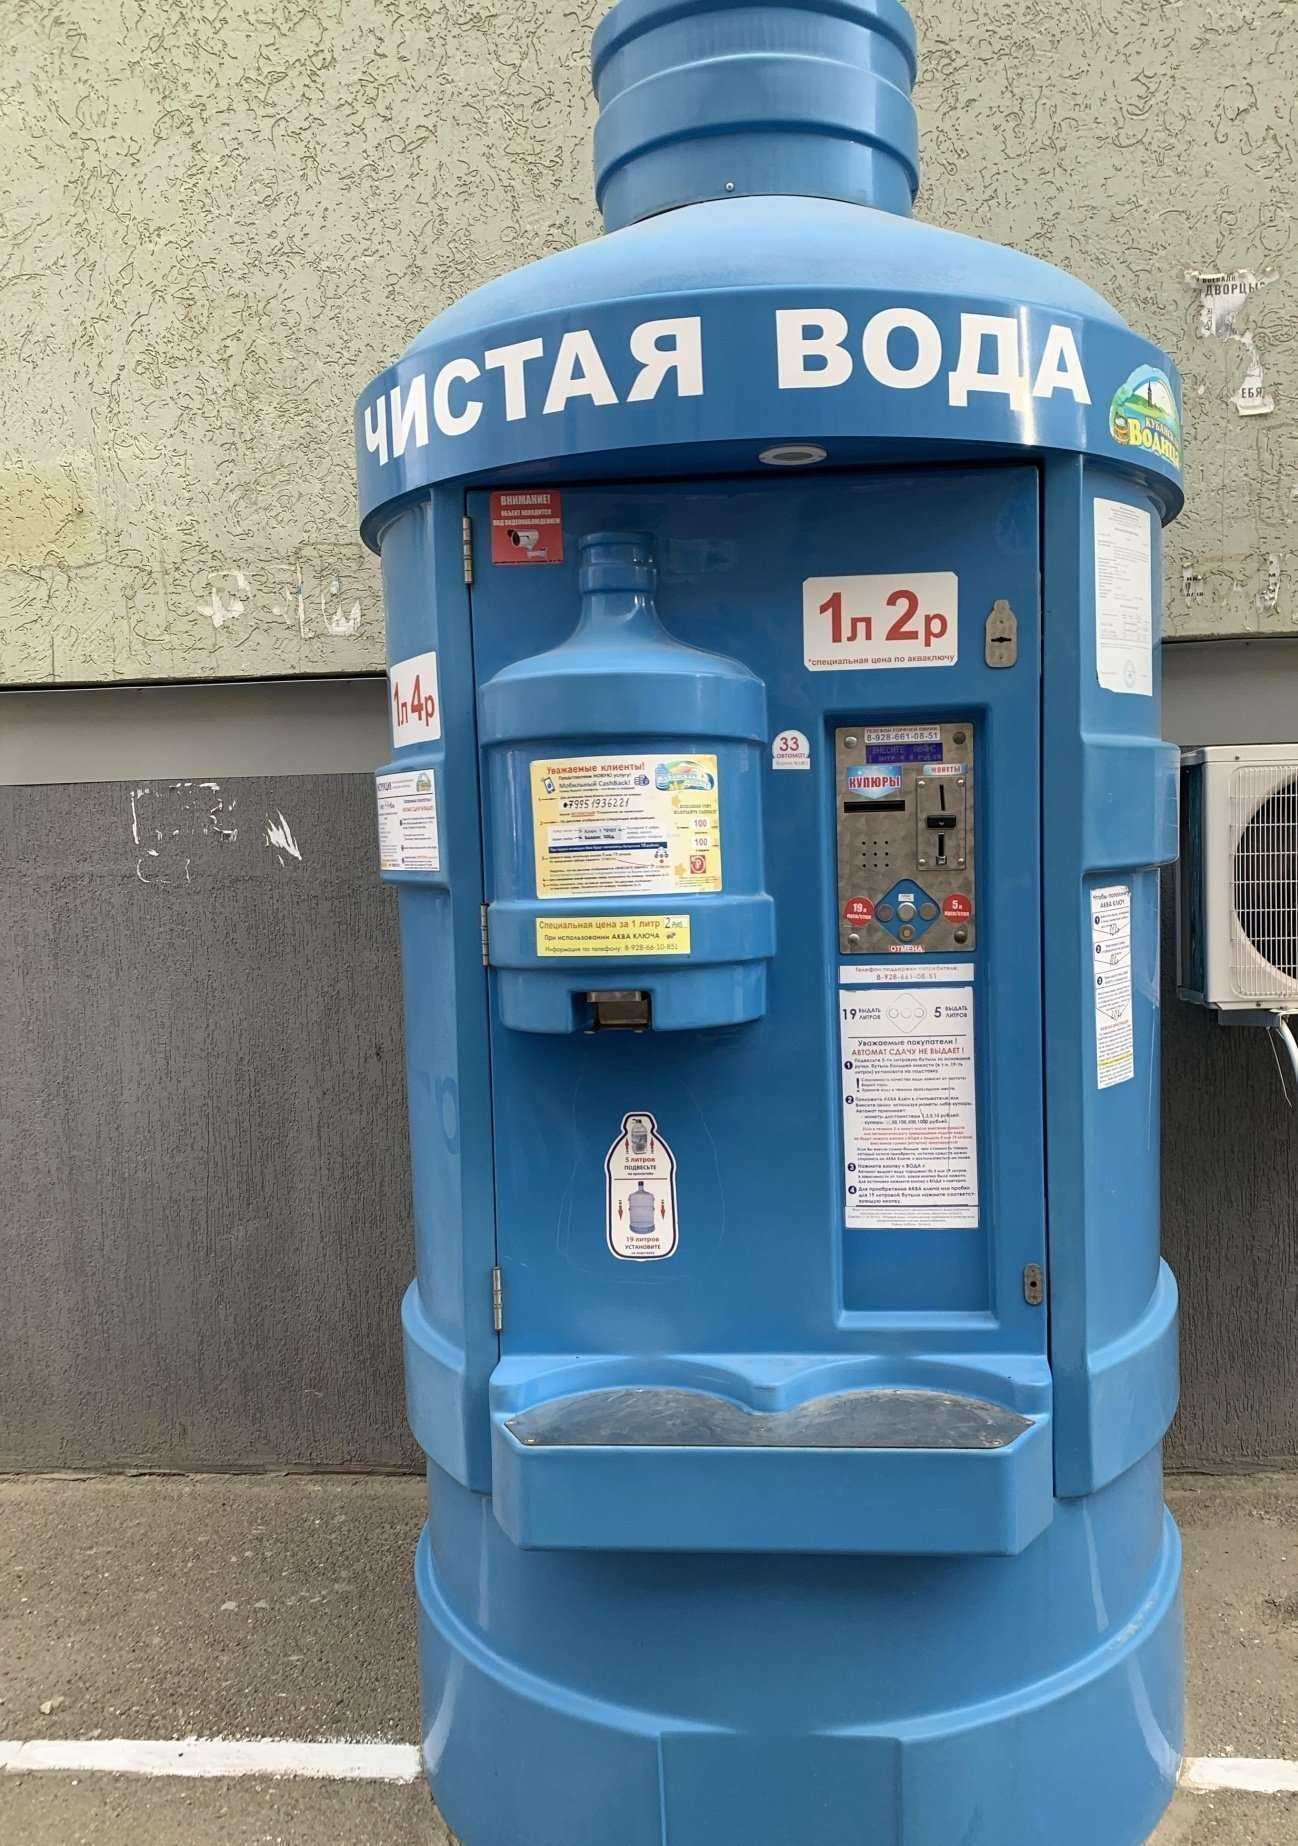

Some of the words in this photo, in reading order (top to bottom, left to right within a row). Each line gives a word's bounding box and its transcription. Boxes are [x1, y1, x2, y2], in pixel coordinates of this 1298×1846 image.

[364, 316, 704, 466] ЧИСТАЯ
[775, 307, 1092, 411] ВОДА
[819, 591, 872, 643] 1л
[885, 589, 948, 647] 2р
[871, 656, 892, 666] цена
[907, 654, 955, 664] акваключу
[394, 681, 409, 727] 1л
[410, 674, 436, 727] 4р
[779, 736, 800, 752] 33
[547, 766, 598, 776] Уважаемые
[849, 776, 900, 788] КУПЮРЫ
[852, 903, 862, 912] 19
[952, 900, 958, 910] 5
[539, 920, 593, 930] Специальная
[595, 922, 617, 930] цена
[639, 920, 660, 928] литр
[842, 1008, 857, 1020] 19
[934, 1006, 942, 1018] 5
[635, 1236, 660, 1244] литров
